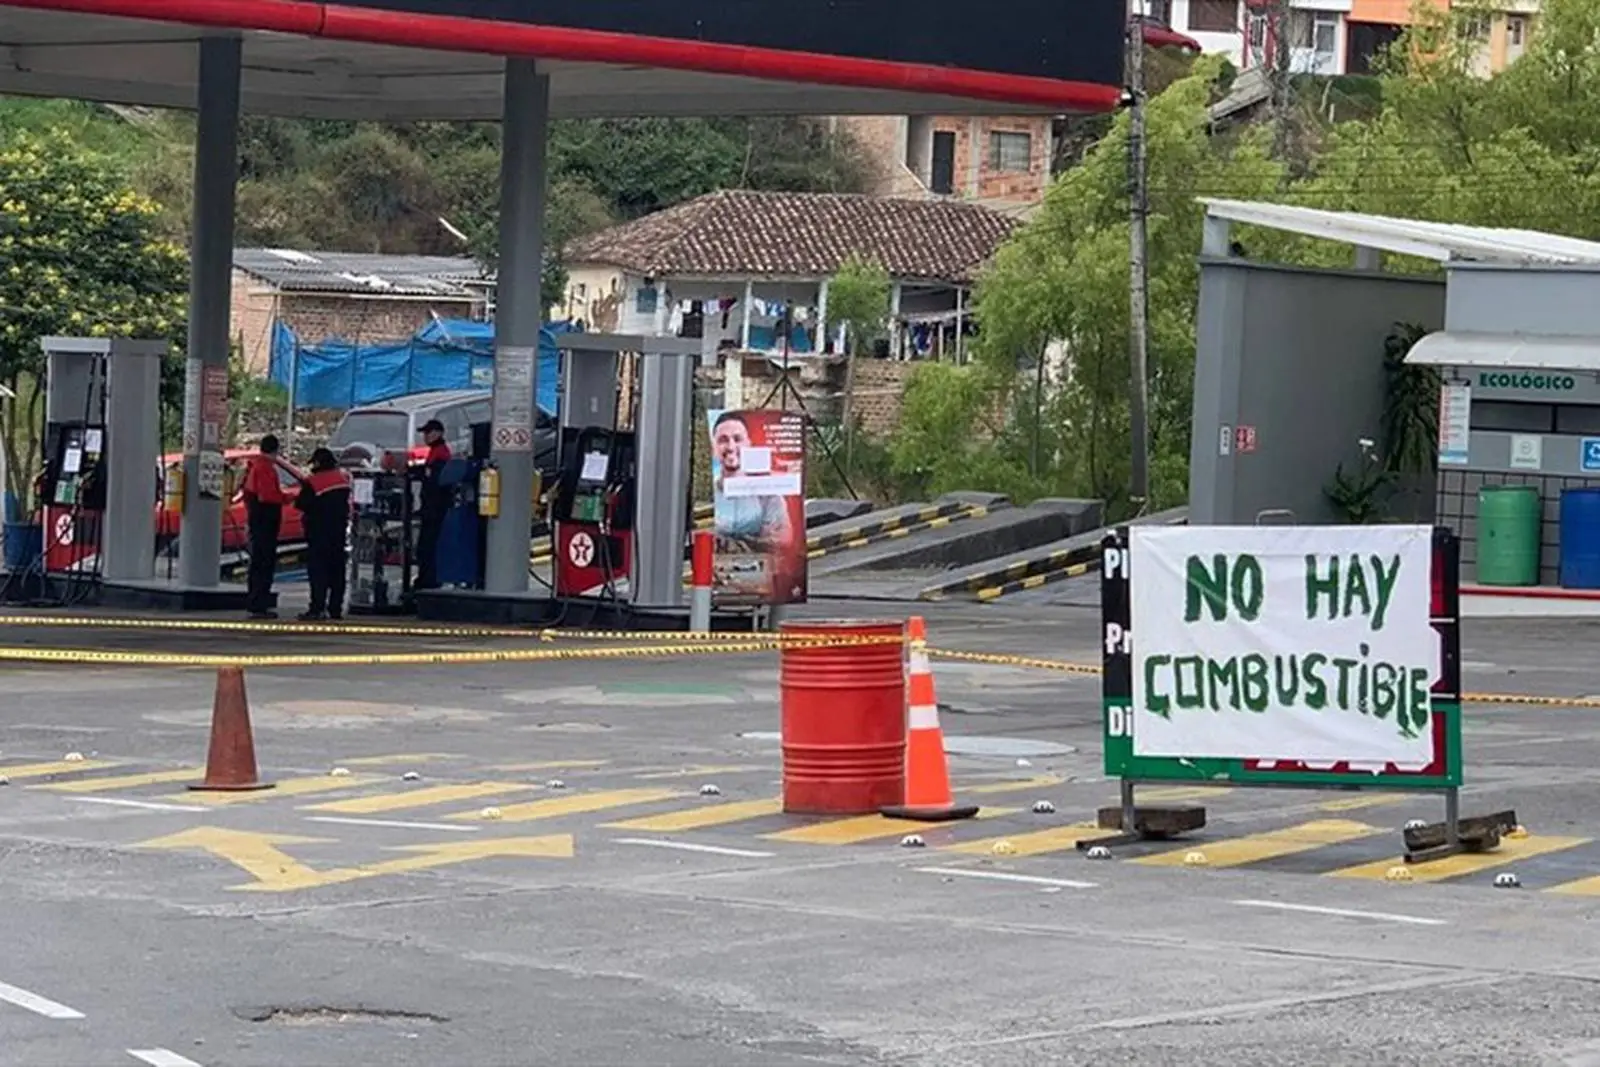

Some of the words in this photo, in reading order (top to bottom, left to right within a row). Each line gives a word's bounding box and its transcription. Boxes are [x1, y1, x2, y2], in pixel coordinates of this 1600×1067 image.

[1480, 371, 1575, 390] ECOLÓGICO
[1185, 554, 1263, 621] NO
[1307, 554, 1401, 630] HAY
[1108, 705, 1133, 737] Di
